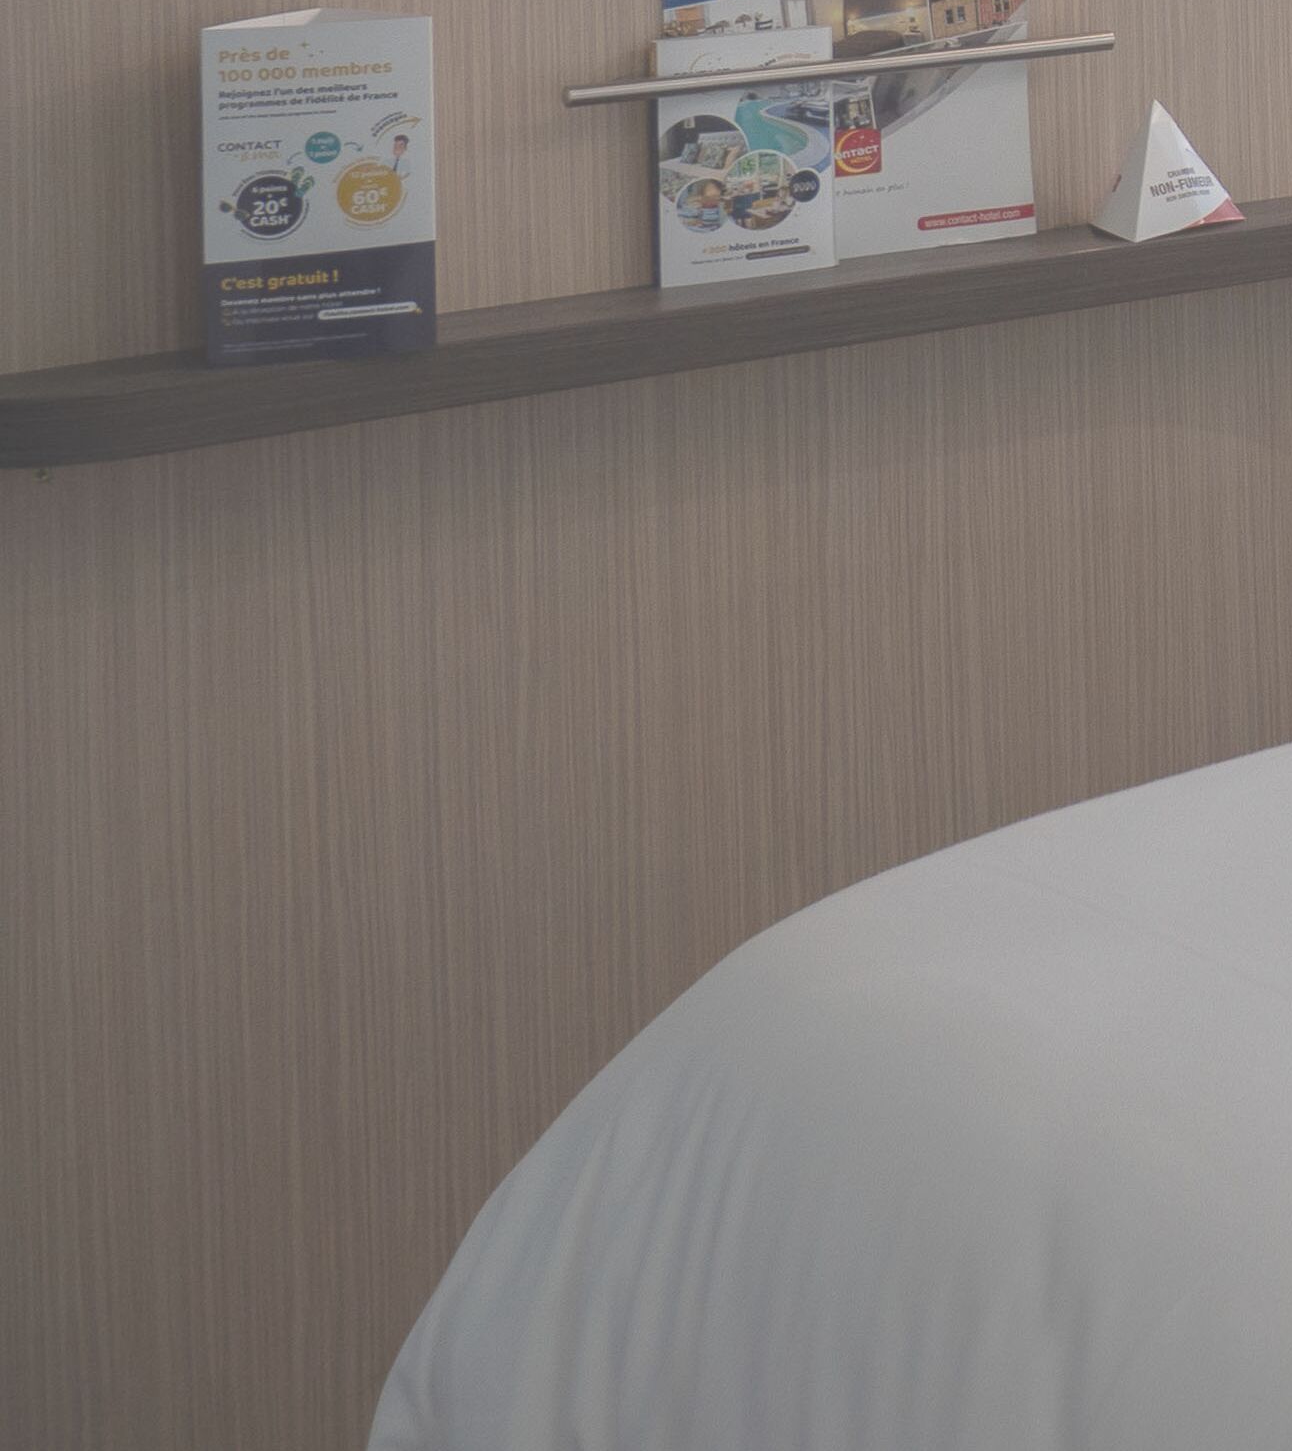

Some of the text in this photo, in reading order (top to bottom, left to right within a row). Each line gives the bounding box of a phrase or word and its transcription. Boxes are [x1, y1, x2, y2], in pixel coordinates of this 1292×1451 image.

[218, 47, 290, 63] Près de
[218, 61, 393, 83] 100 000 membres
[218, 89, 272, 101] Rejoignez
[295, 87, 315, 95] des
[317, 83, 368, 94] meilleurs
[218, 99, 287, 111] programmes
[305, 94, 346, 105] fidélité
[347, 93, 360, 101] de
[362, 91, 399, 101] France
[216, 140, 283, 153] CONTACT
[352, 187, 389, 205] 60€
[1150, 176, 1215, 197] NON-FUMEUR
[253, 196, 289, 216] 20€
[924, 209, 1021, 229] www.contact-hotel.com
[771, 237, 800, 248] France
[221, 269, 339, 291] C'est gratuit !
